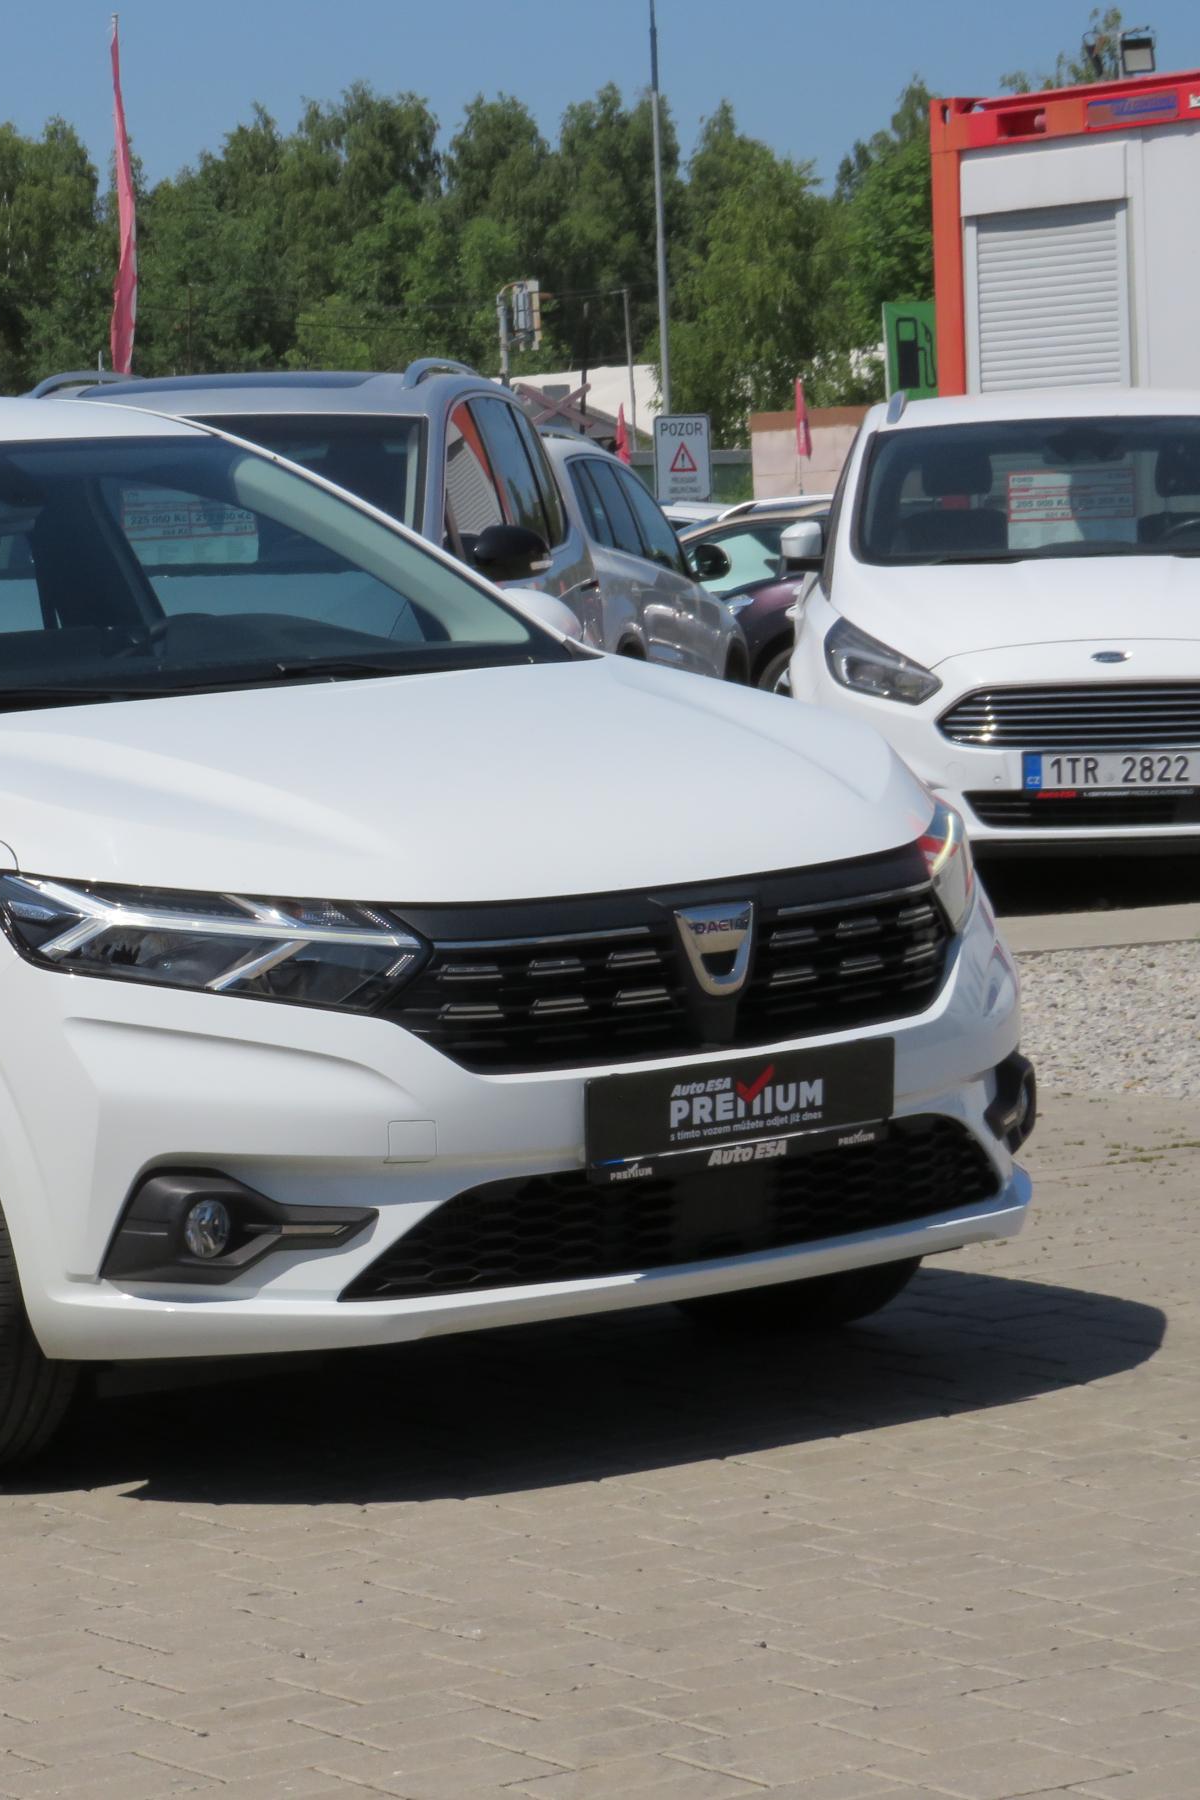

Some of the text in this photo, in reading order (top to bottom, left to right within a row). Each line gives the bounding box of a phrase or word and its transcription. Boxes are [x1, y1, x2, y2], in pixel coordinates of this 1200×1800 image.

[660, 422, 704, 437] POZOR
[1026, 776, 1040, 784] CZ
[1051, 755, 1190, 784] 1TR 2822
[670, 1077, 732, 1098] Auto ESA
[670, 1078, 823, 1129] PREMIUM
[670, 1133, 675, 1141] s
[703, 1125, 731, 1137] vozem
[766, 1114, 788, 1127] odjet
[802, 1110, 822, 1121] dnes
[708, 1140, 788, 1167] Auto ESA
[610, 1166, 653, 1181] PREMIUM
